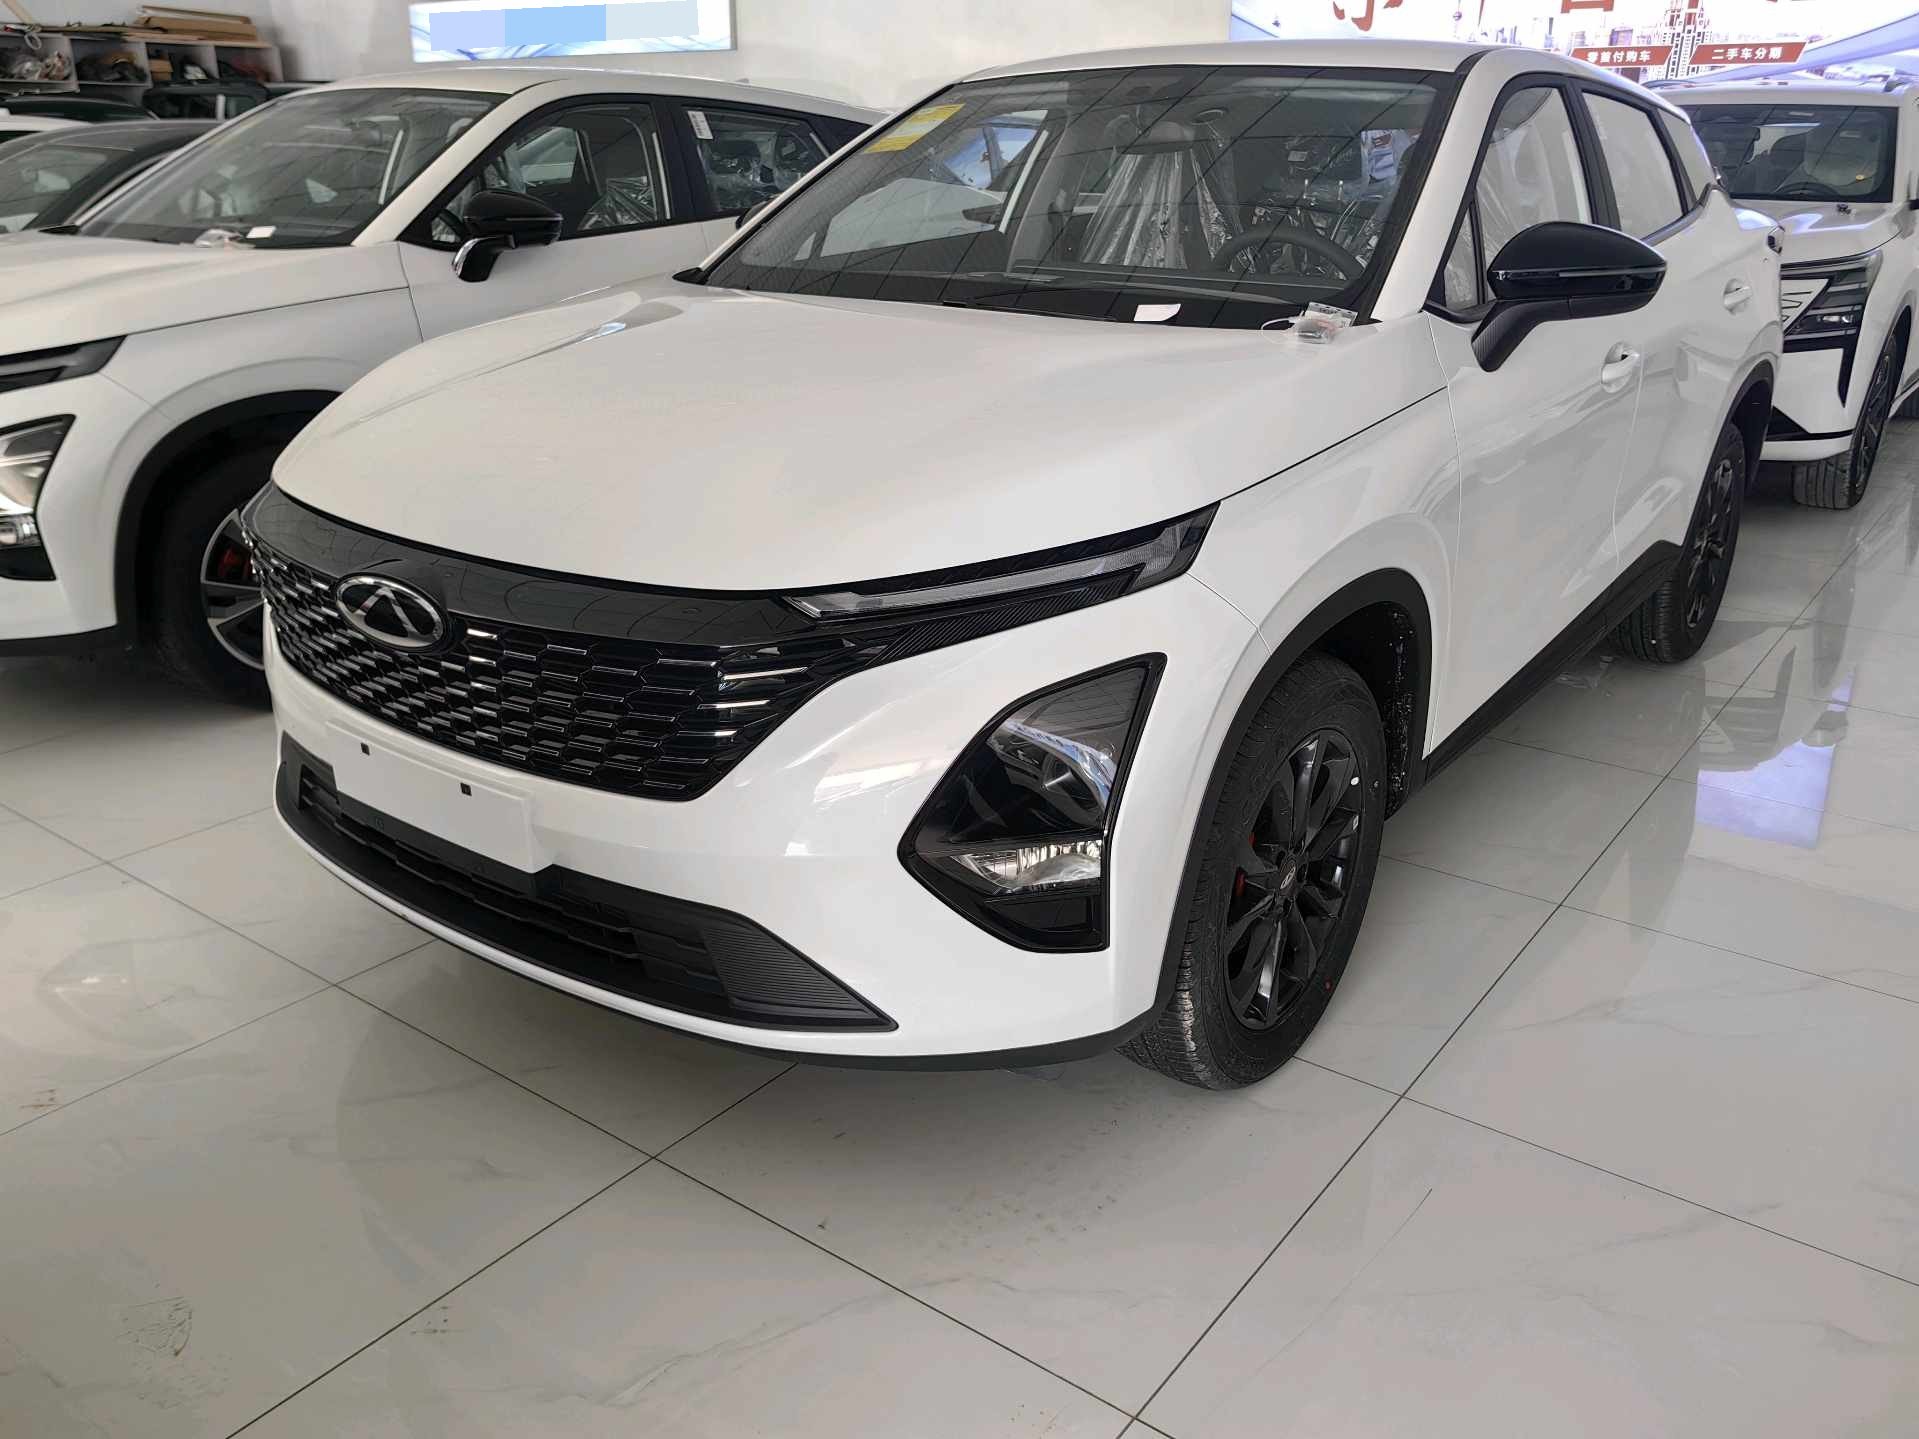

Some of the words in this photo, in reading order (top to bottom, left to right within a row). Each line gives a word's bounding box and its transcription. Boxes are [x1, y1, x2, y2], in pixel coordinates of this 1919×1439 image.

[1587, 50, 1651, 63] 零首付购车
[1711, 47, 1783, 60] 二手车分期
